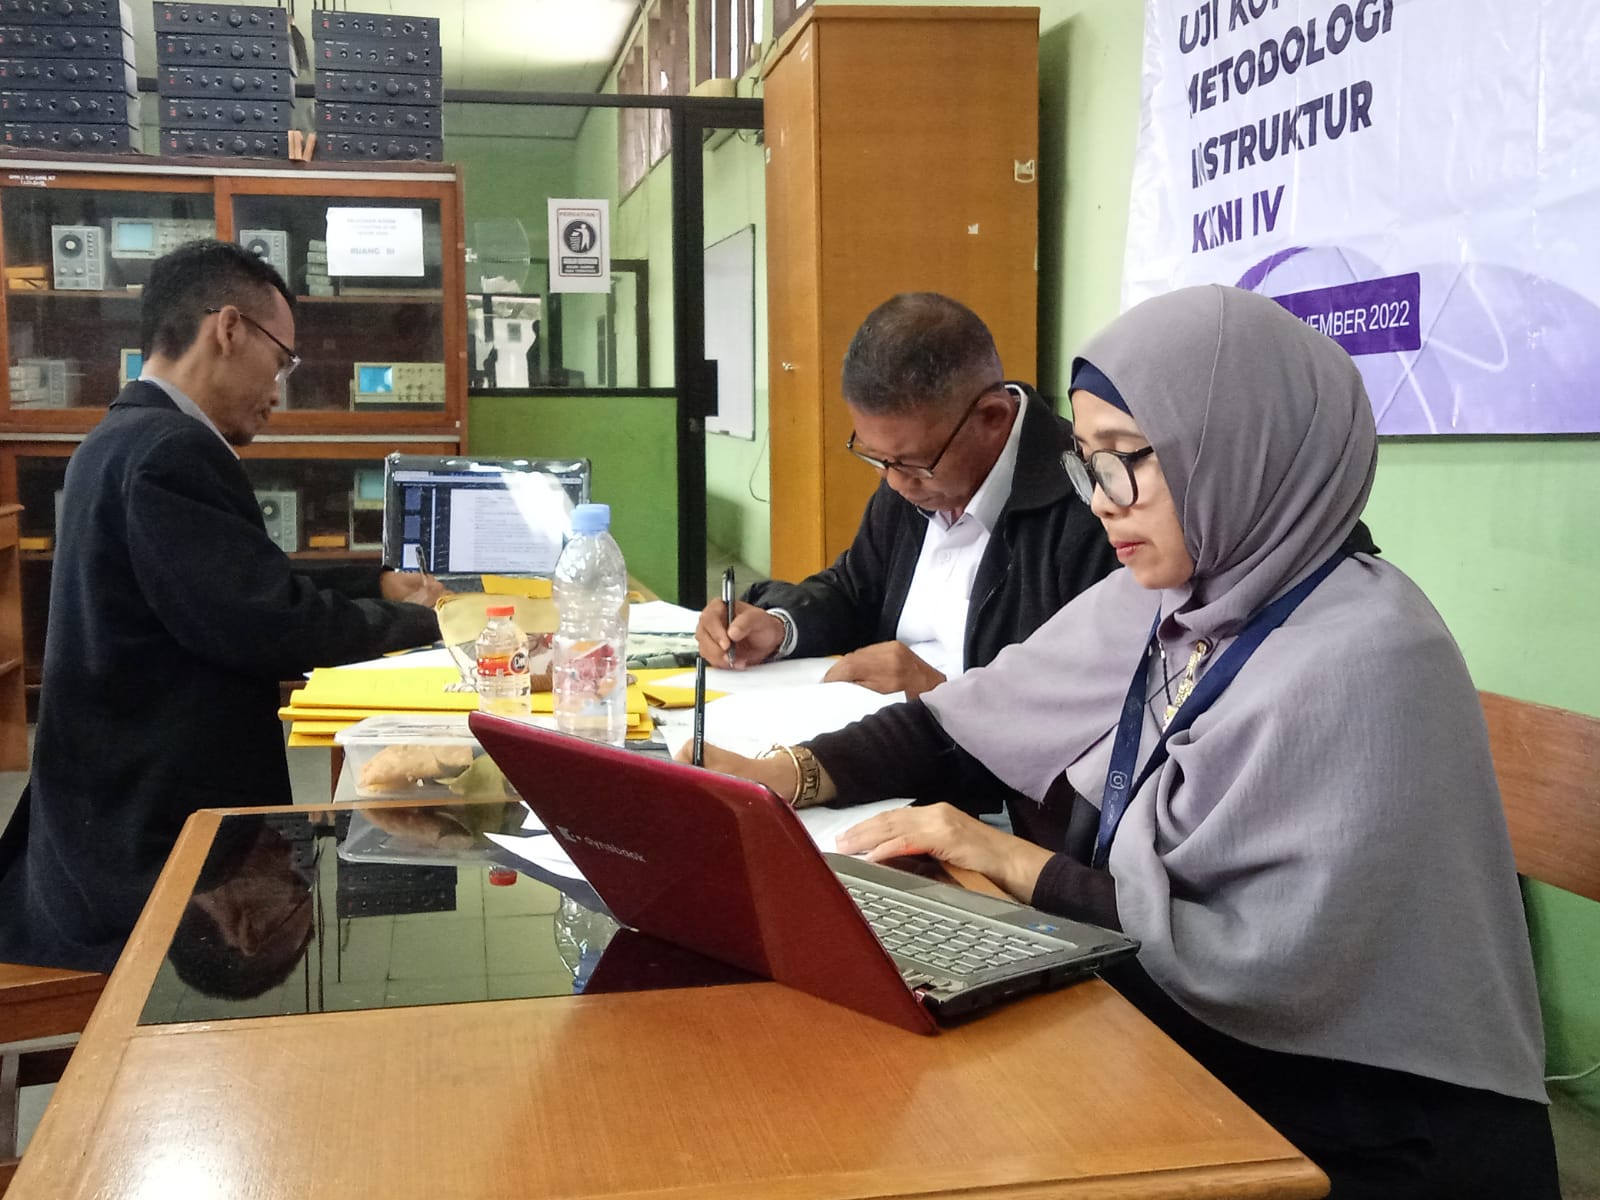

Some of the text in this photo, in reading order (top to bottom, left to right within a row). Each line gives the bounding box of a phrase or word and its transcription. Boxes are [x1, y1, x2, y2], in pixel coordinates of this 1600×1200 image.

[1179, 0, 1218, 54] UJI
[1252, 184, 1285, 237] IV
[1369, 300, 1410, 330] 2022
